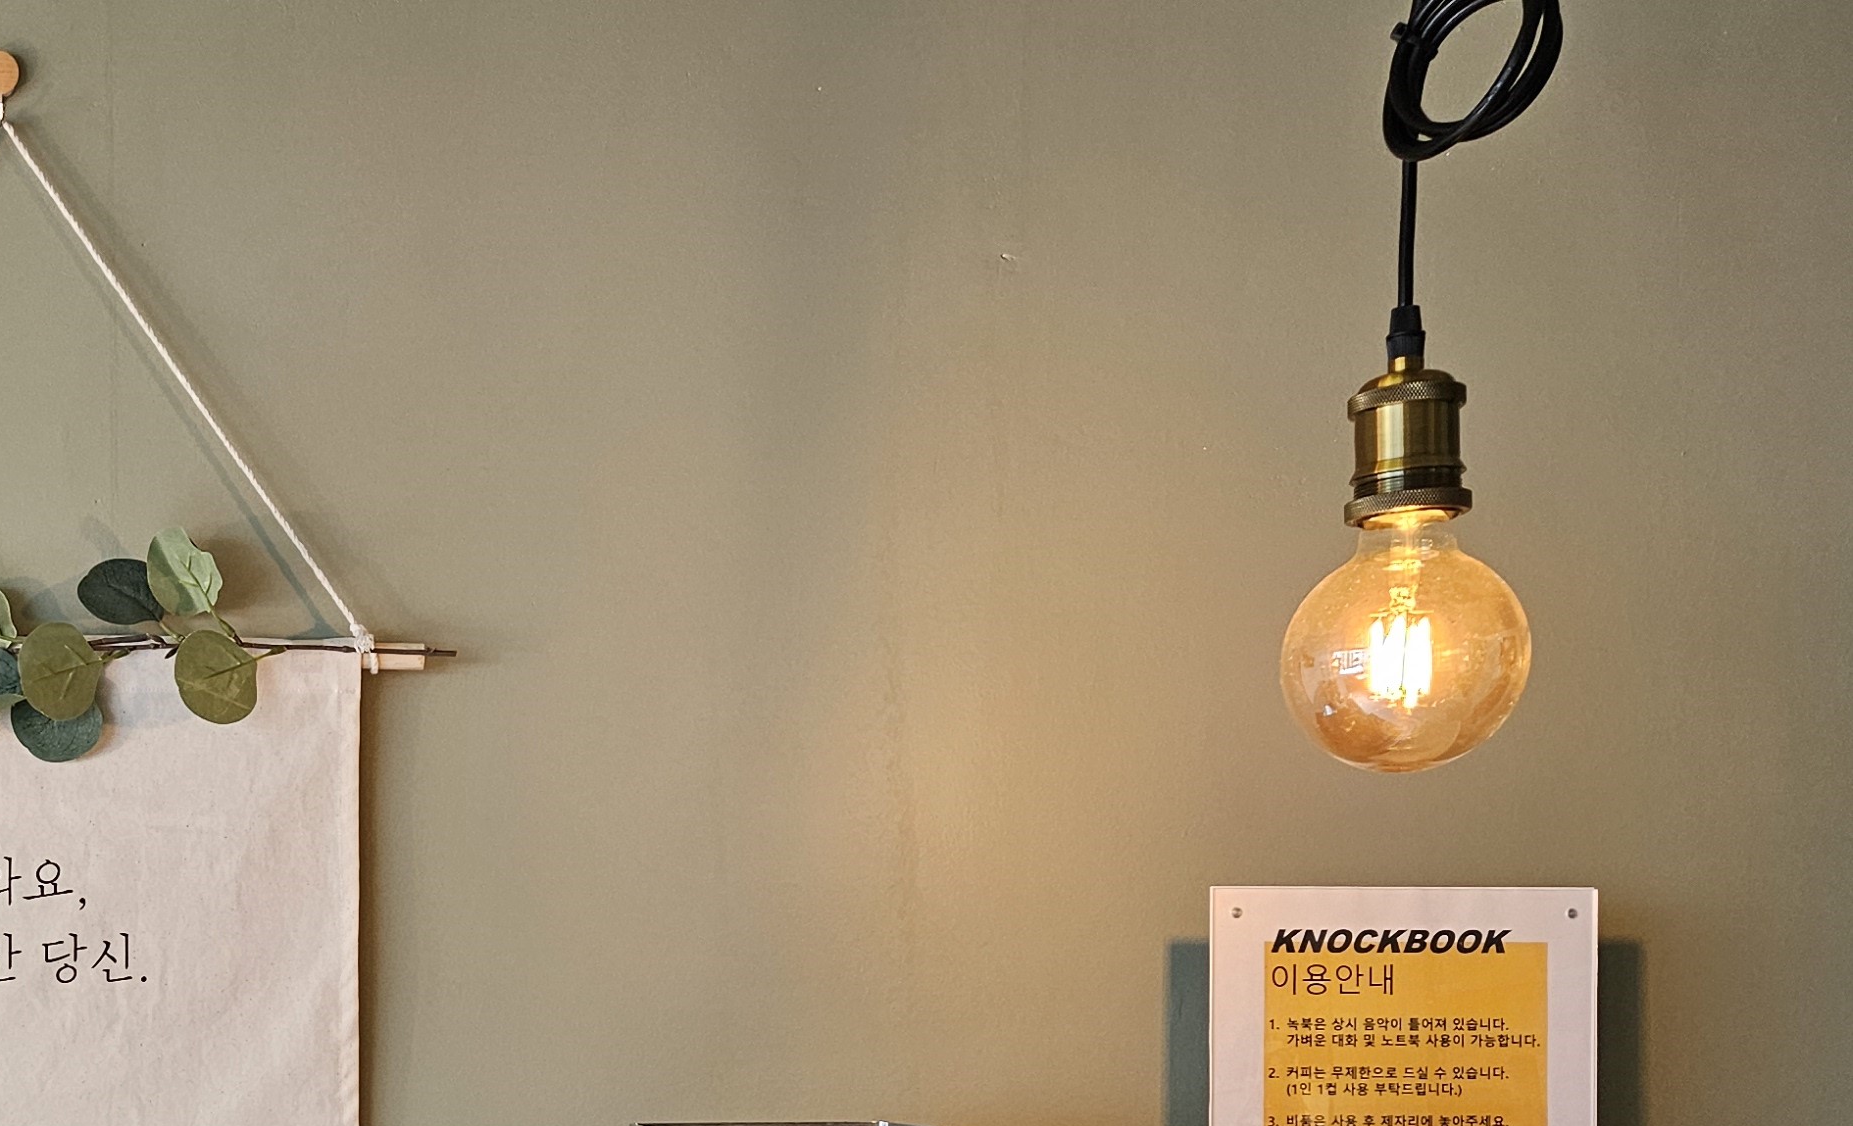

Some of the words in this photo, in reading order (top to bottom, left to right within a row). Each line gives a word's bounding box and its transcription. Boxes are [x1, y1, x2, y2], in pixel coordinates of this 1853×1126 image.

[1271, 929, 1512, 954] KNOCKBOOK
[42, 933, 147, 983] 당신.
[1272, 964, 1393, 995] 이용안내
[1269, 1019, 1279, 1029] 1.
[1287, 1018, 1326, 1031] 녹북은
[1332, 1017, 1356, 1031] 상시
[1363, 1017, 1401, 1031] 음악이
[1453, 1018, 1509, 1031] 있습니다.
[1287, 1034, 1326, 1047] 가벼운
[1332, 1034, 1358, 1047] 대화
[1364, 1034, 1375, 1047] 및
[1381, 1034, 1420, 1047] 노트북
[1426, 1034, 1464, 1047] 사용이
[1471, 1034, 1540, 1048] 가능합니다.
[1268, 1068, 1279, 1078] 2.
[1287, 1066, 1326, 1079] 커피는
[1331, 1066, 1397, 1079] 무제한으로
[1403, 1066, 1428, 1079] 드실
[1434, 1067, 1446, 1080] 수
[1453, 1066, 1509, 1080] 있습니다.
[1287, 1083, 1311, 1097] (1인
[1317, 1083, 1336, 1095] 1컵
[1343, 1083, 1369, 1096] 사용
[1268, 1116, 1279, 1126] 3.
